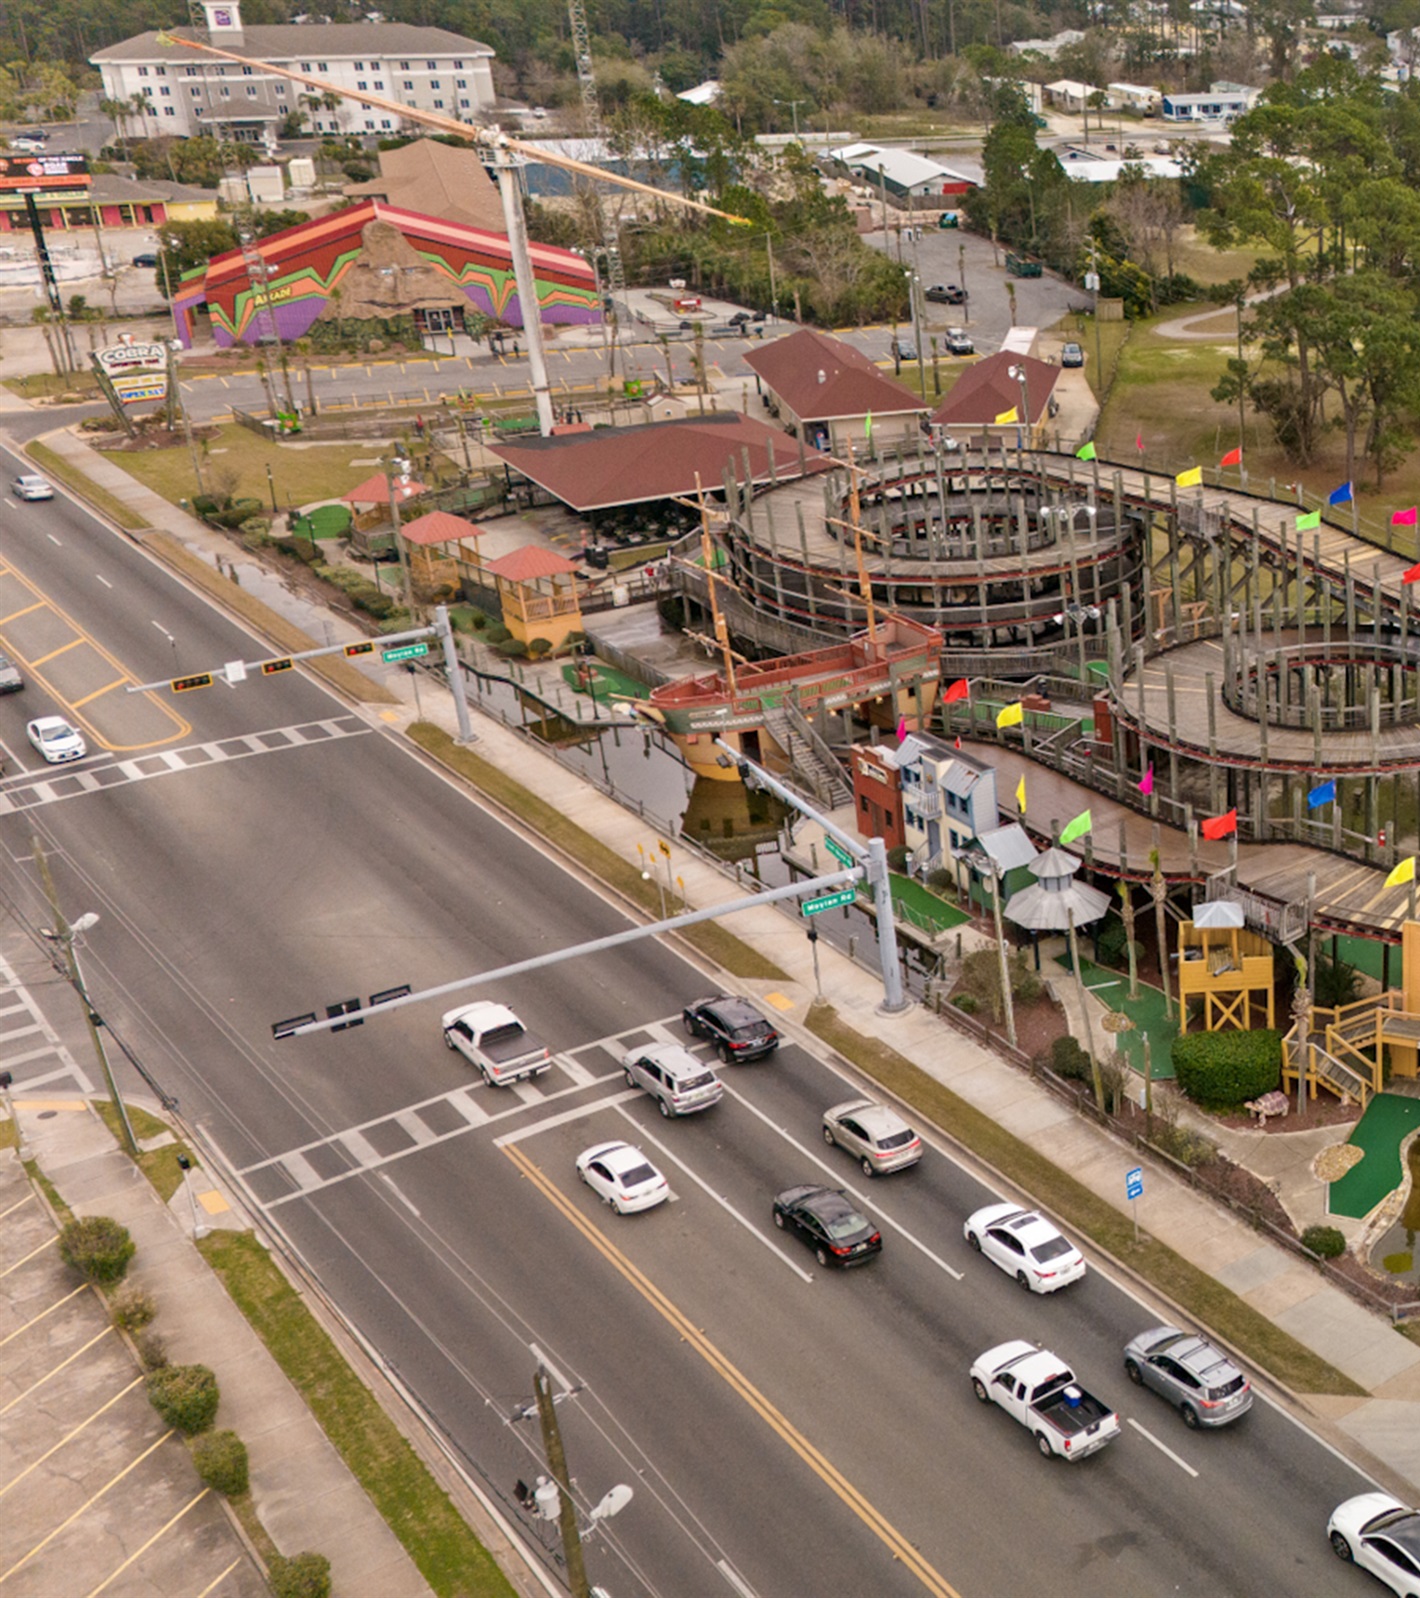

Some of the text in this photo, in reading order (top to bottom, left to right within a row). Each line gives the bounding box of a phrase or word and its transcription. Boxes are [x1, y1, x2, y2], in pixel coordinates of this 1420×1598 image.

[254, 287, 291, 306] ARCADE
[101, 345, 164, 364] COBRA
[807, 893, 852, 911] Moylan Rd
